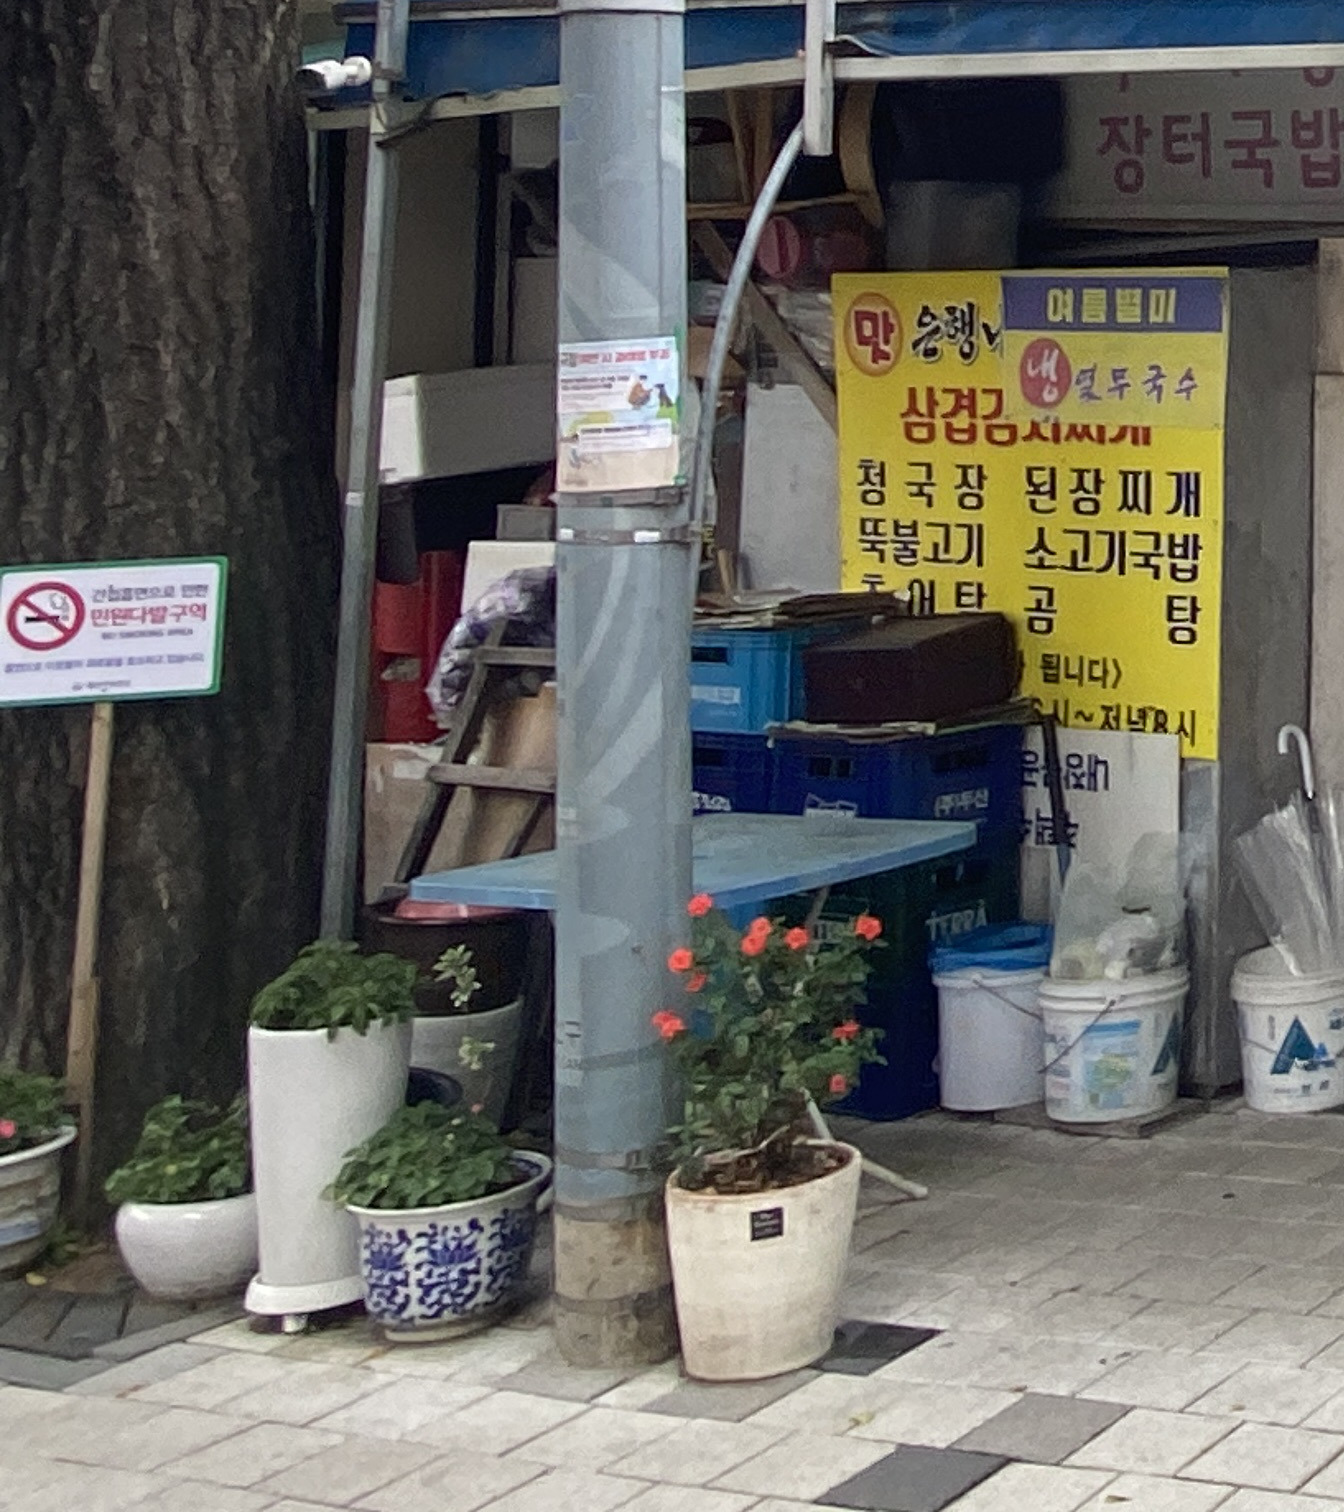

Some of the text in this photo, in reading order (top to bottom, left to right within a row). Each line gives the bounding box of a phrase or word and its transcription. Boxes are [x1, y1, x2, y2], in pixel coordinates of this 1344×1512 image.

[1047, 287, 1177, 326] 여름별미
[853, 309, 894, 365] 맛
[1026, 345, 1200, 404] 냉 열무국수
[1024, 464, 1202, 519] 된장찌개
[858, 517, 1203, 584] 뚝불고기 소고기국밥
[90, 602, 207, 627] 민원다발구역
